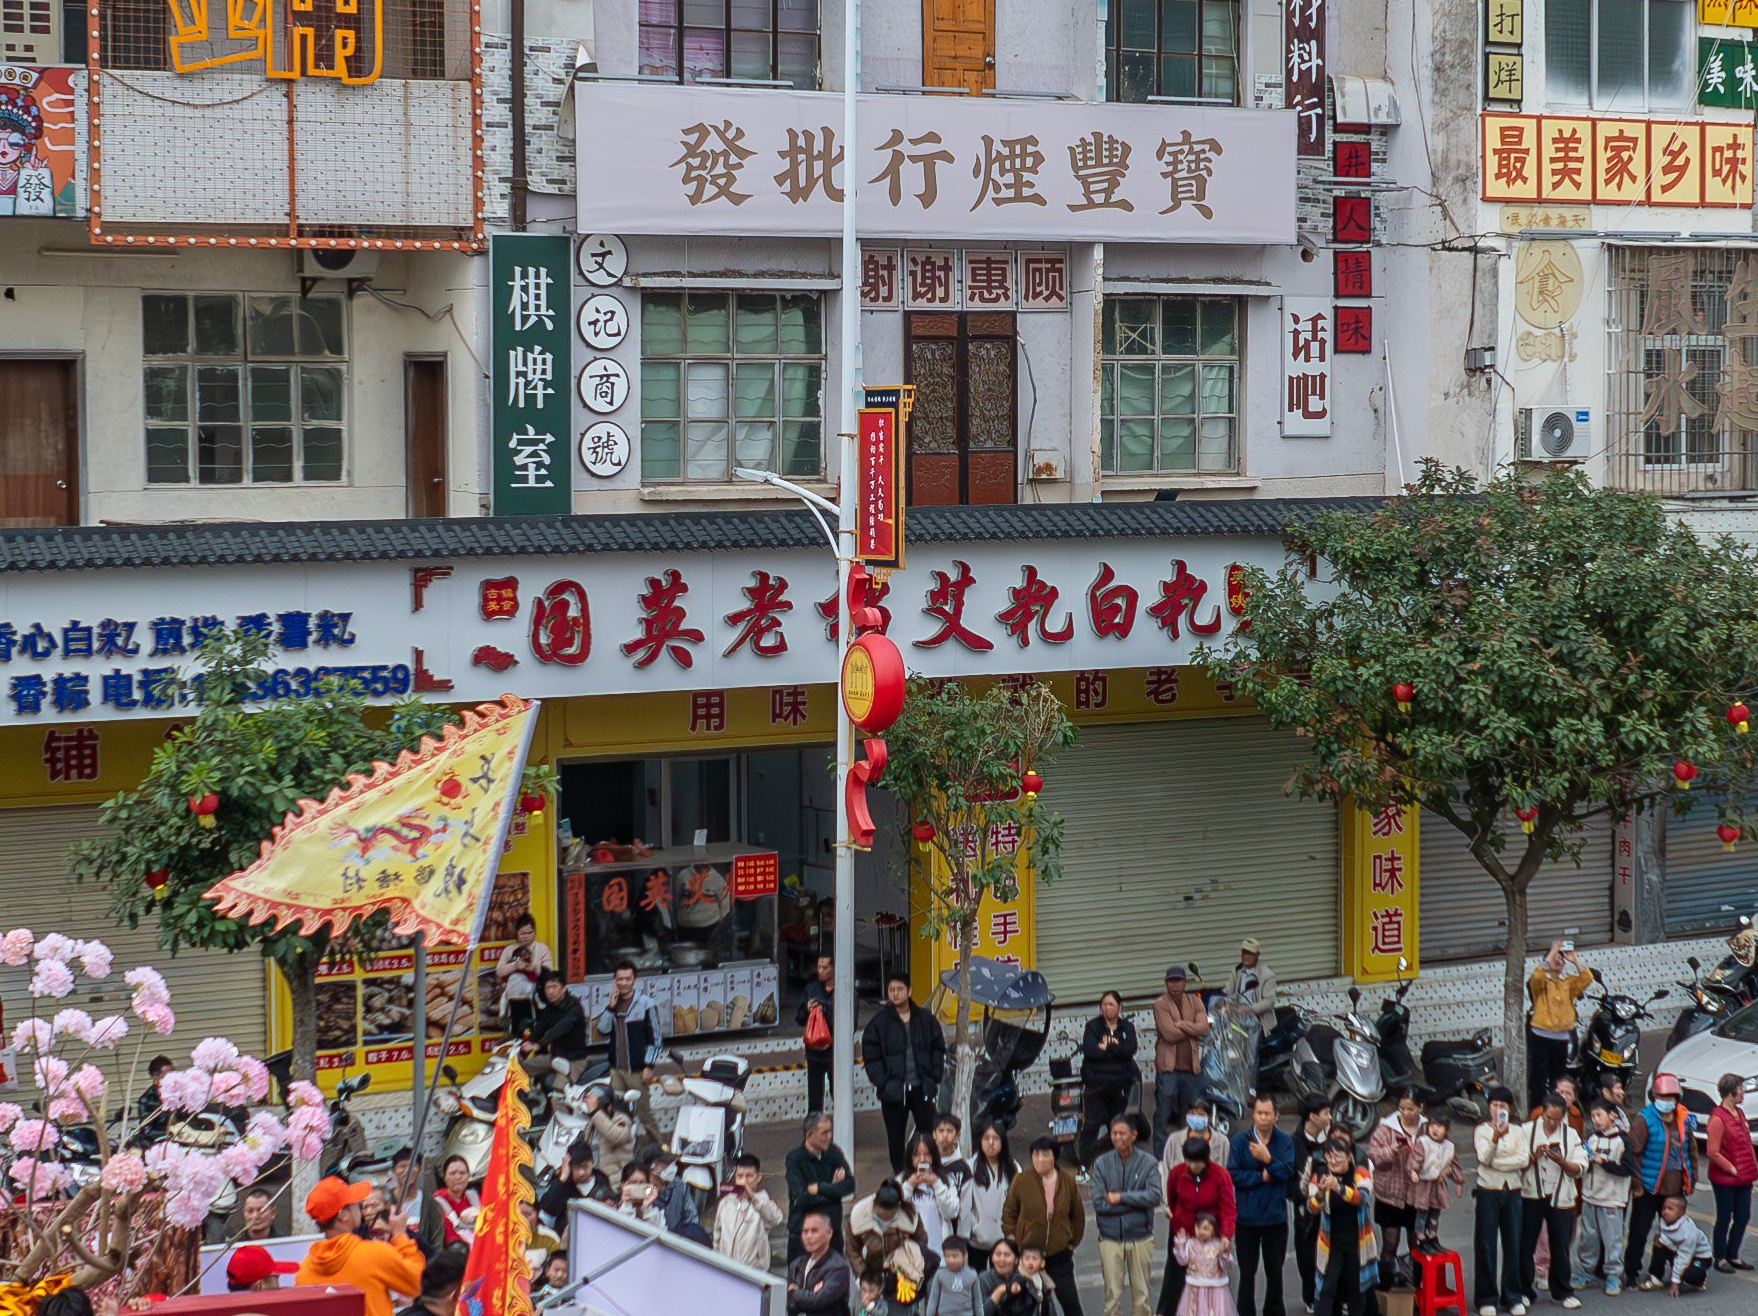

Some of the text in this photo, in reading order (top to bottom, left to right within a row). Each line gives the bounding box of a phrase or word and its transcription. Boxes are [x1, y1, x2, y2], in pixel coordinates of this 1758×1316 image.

[19, 172, 52, 204] 發
[1492, 125, 1749, 197] 最美家乡味
[506, 266, 557, 491] 棋牌室
[1286, 310, 1328, 420] 话吧
